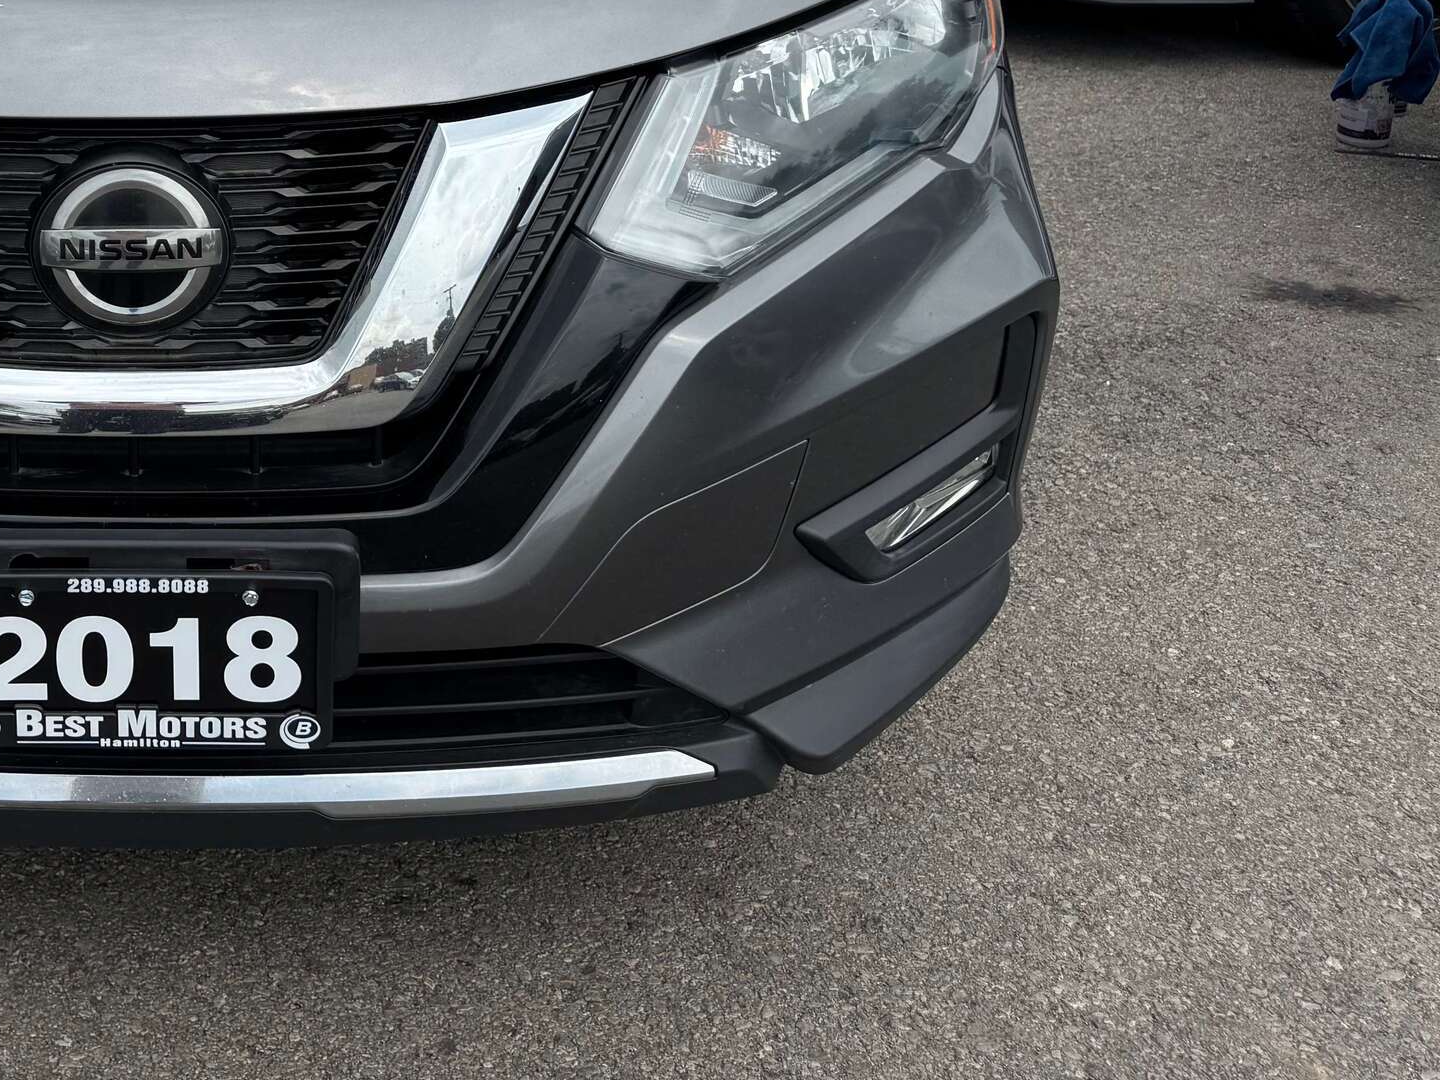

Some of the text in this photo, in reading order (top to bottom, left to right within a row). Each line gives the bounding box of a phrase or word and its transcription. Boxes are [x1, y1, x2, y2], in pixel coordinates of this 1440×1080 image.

[59, 238, 203, 261] NISSAN
[67, 577, 210, 595] 289.988.8088
[16, 708, 268, 740] BEST MOTORS
[100, 737, 182, 749] Hamilton
